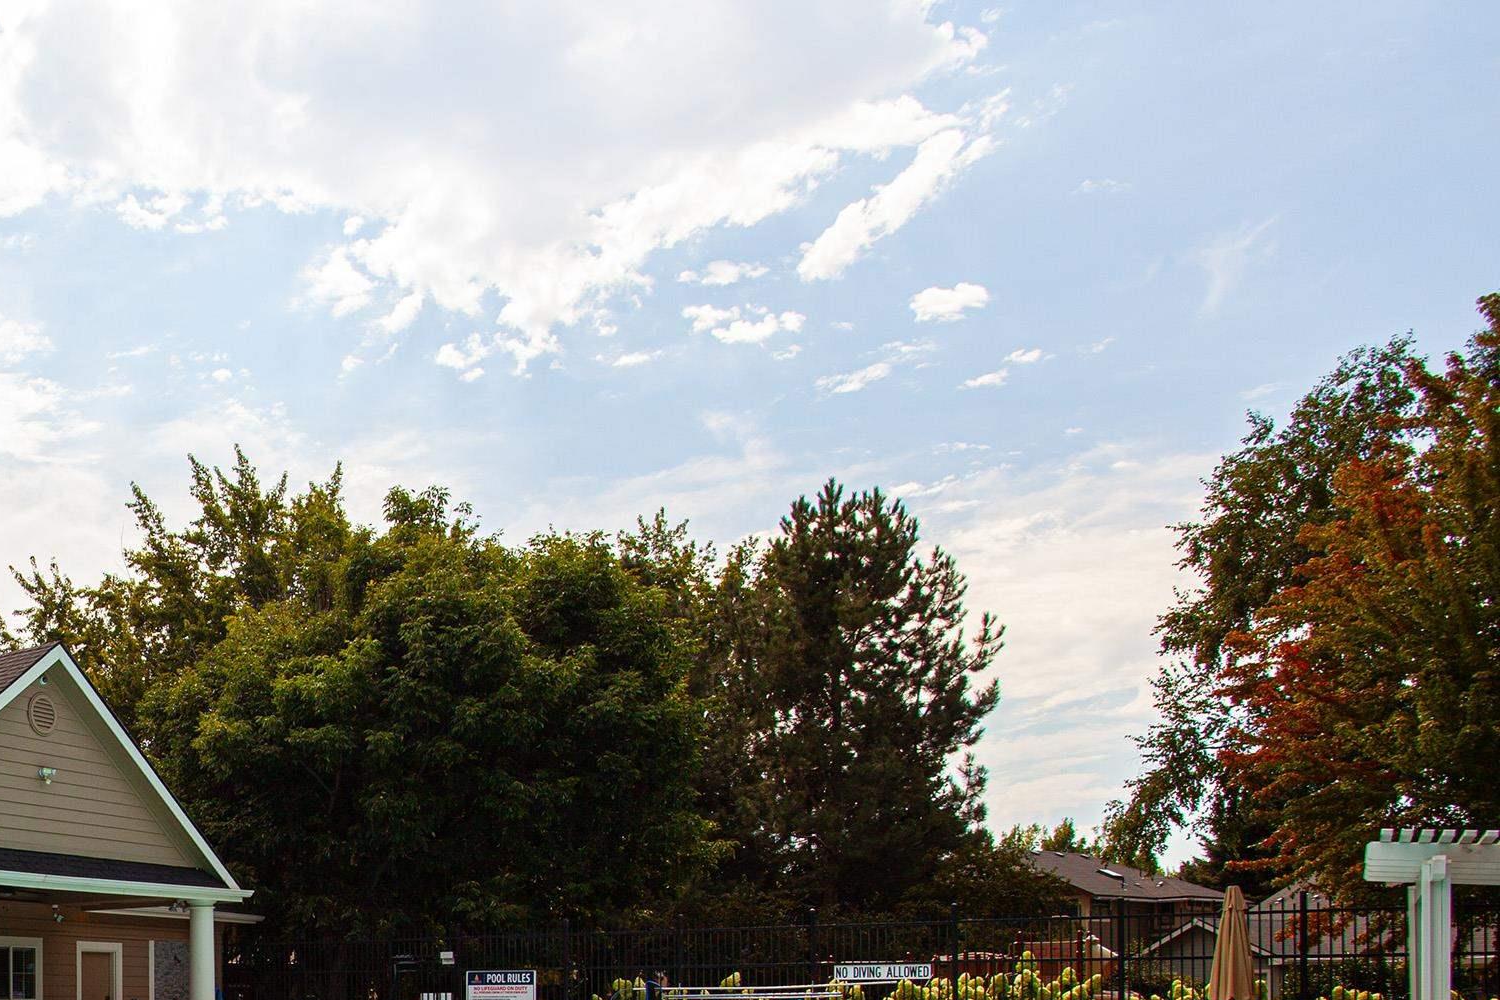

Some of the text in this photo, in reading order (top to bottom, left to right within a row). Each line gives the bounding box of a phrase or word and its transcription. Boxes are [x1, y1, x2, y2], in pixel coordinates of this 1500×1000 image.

[835, 966, 929, 978] NO DIVING ALLOWED
[486, 973, 531, 983] POOL RULES
